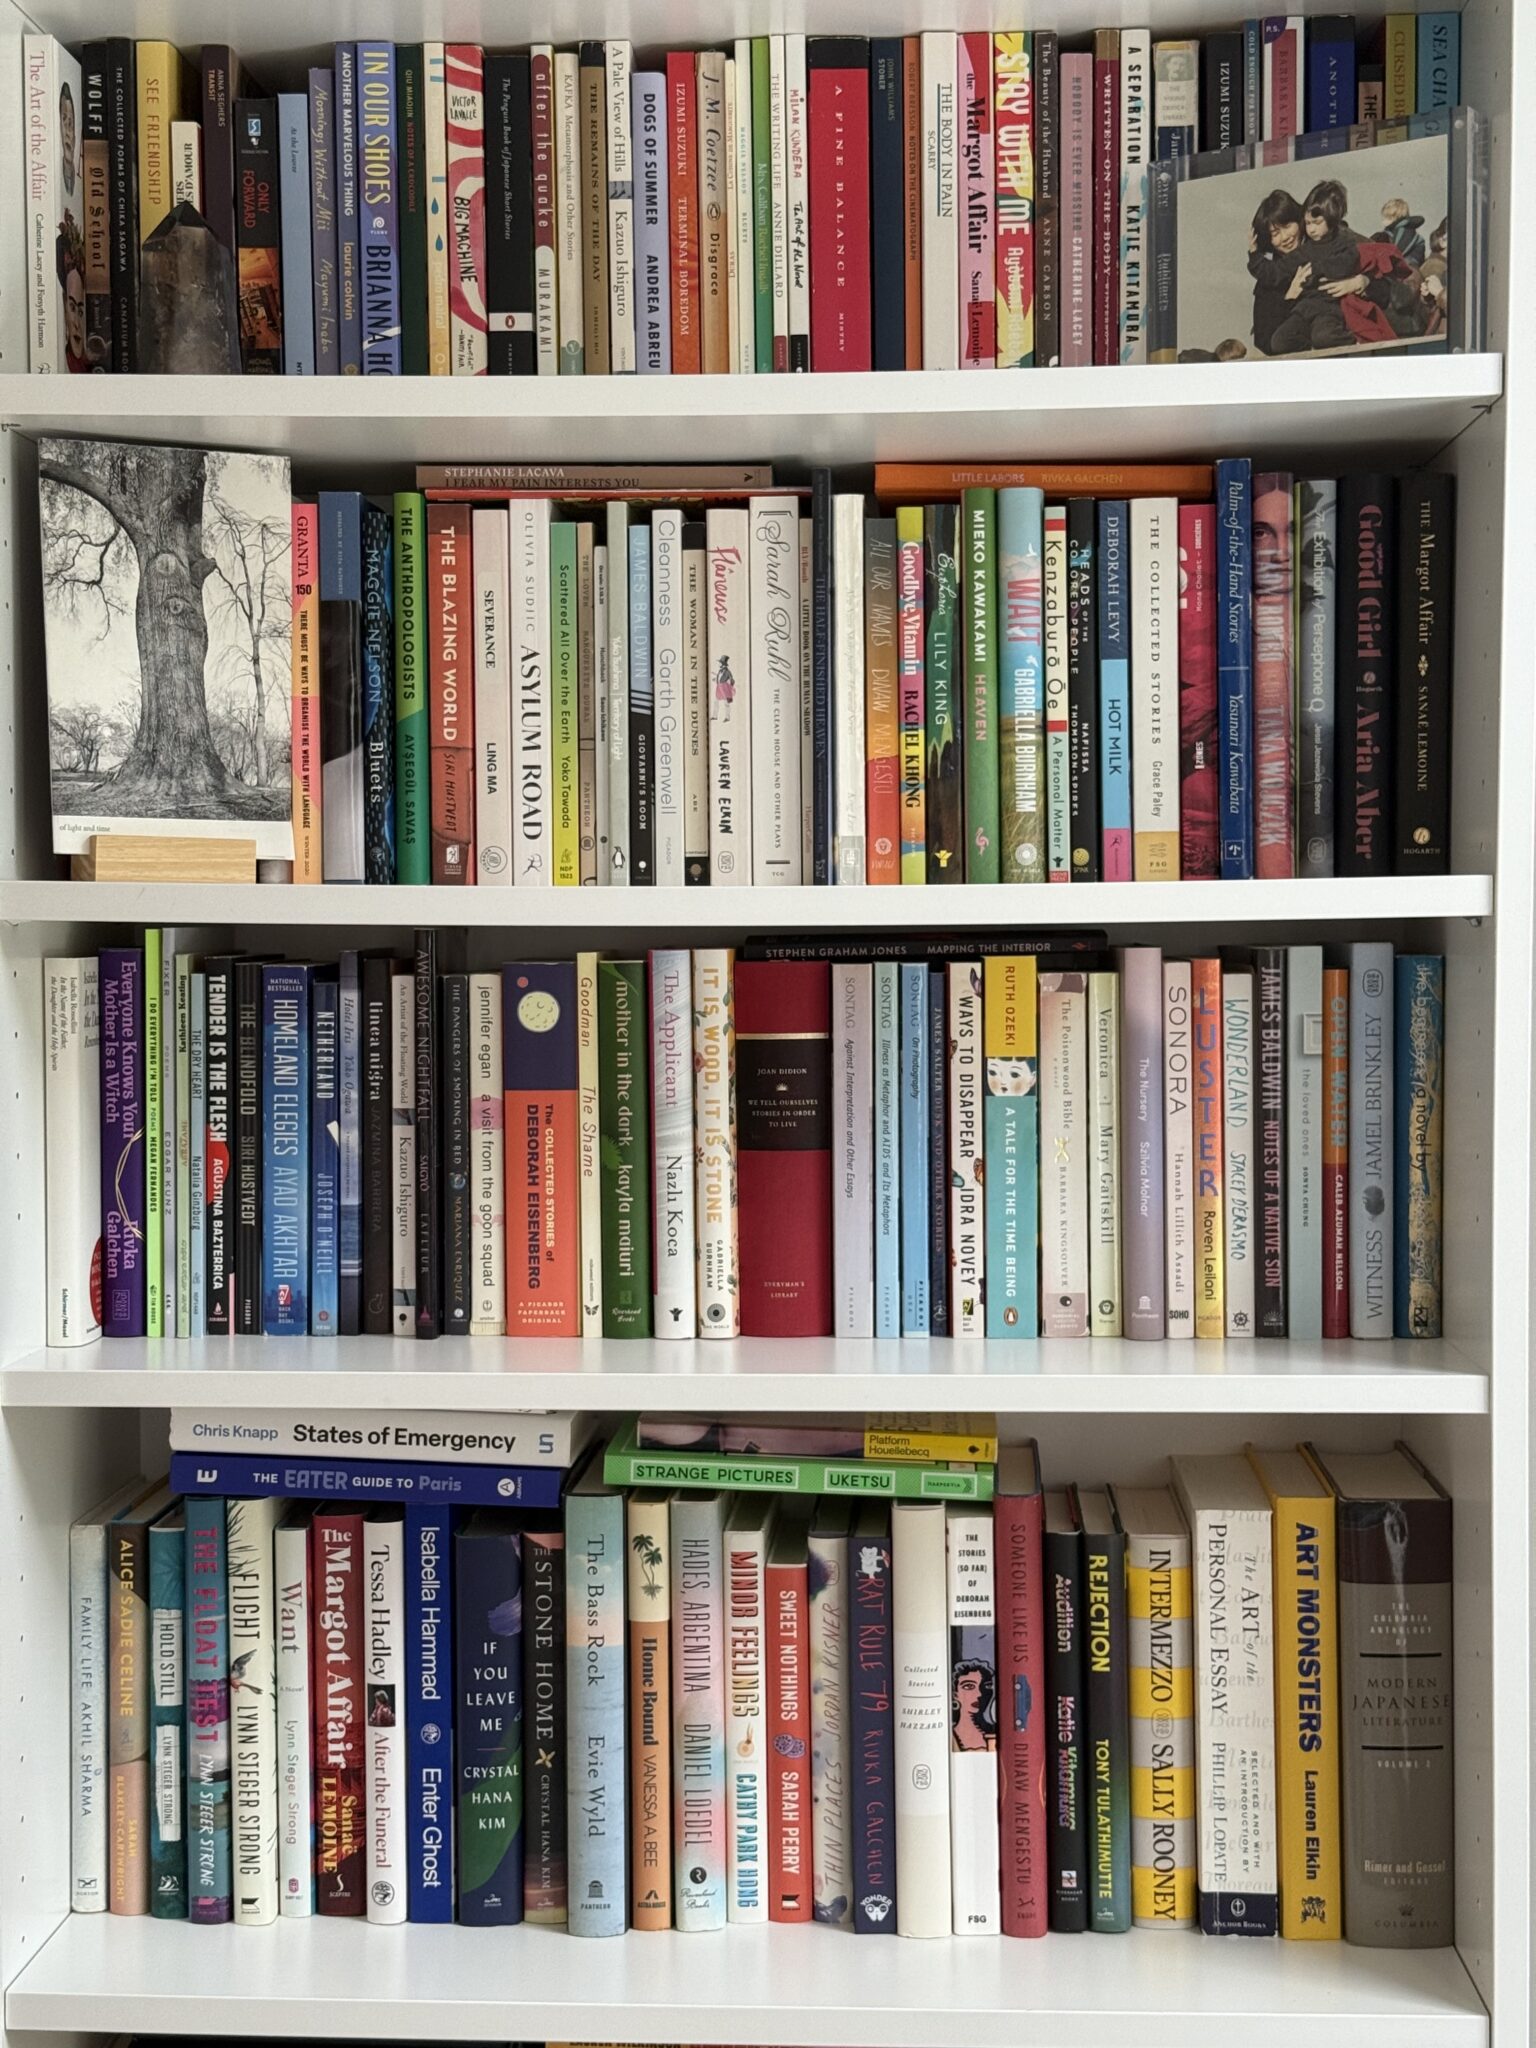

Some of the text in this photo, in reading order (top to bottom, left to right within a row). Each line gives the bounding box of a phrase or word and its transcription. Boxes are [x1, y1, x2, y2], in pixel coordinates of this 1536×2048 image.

[30, 51, 46, 201] The Art of the Affair
[88, 74, 102, 134] WOLFF
[147, 78, 161, 205] SEE FRIENDSHIP
[342, 52, 354, 216] ANOTHER MARVELOUS THING
[364, 52, 391, 204] IN OUR SHOES
[536, 74, 551, 227] after the quake
[644, 94, 657, 225] DOGS OF SUMMER
[1127, 64, 1142, 165] SEPARATION
[118, 181, 125, 193] OF
[118, 197, 126, 226] CHIKA
[835, 85, 845, 287] A FINE BALANCE
[34, 213, 45, 348] Catherine Lacey and Forsyth Harmon
[119, 231, 127, 272] SAGAWA
[538, 269, 552, 354] MURAKAMI
[646, 255, 660, 369] ANDREA ABREU
[1126, 205, 1140, 343] KATIE KITAMURA
[295, 585, 312, 595] 150
[296, 516, 308, 577] GRANTA
[401, 508, 416, 700] THE ANTHROPOLOGISTS
[1106, 516, 1121, 643] DEBORAH LEVY
[1225, 481, 1244, 644] Palm-of-the-Hand Stories
[1416, 500, 1435, 644] THE Margot Affair
[440, 526, 457, 741] THE BLAZING WORLD
[560, 565, 571, 743] Scattered All Over the Earth
[300, 610, 311, 829] THERE MUST BE WAYS TO ORGANISE THE WORLD WITH LANGUAGE
[1228, 694, 1244, 814] Yasunari Kawabata
[209, 975, 227, 1142] TENDER IS THE FLESH
[478, 986, 493, 1079] jennifer egan
[1005, 966, 1016, 1047] RUTH OZEKI
[958, 995, 975, 1159] WAYS TO DISAPPEAR
[479, 1094, 494, 1287] a visit from the goon squad
[526, 1104, 541, 1289] DEBORAH EISENBERG
[544, 1104, 555, 1261] The COLLECTED STORIES of
[1005, 1107, 1016, 1297] A TALE FOR THE TIME BEING
[1203, 1210, 1216, 1300] Raven Leilani
[193, 1424, 279, 1441] Chris Knapp
[253, 1470, 462, 1492] THE EATER GUIDE TO Paris
[293, 1424, 516, 1453] States of Emergency
[636, 1465, 793, 1484] STRANGE PICTURES
[829, 1473, 890, 1488] UKETSU
[80, 1597, 93, 1688] FAMILY LIFE
[159, 1623, 176, 1699] HOLD STILL
[369, 1545, 391, 1679] Tessa Hadley
[421, 1526, 441, 1699] Isabella Hammad
[587, 1534, 604, 1687] The Bass Rock
[779, 1590, 797, 1721] SWEET NOTHINGS
[1089, 1555, 1110, 1672] REJECTION
[1149, 1549, 1173, 1703] INTERMEZZO
[1295, 1522, 1322, 1752] ART MONSTERS
[81, 1702, 93, 1817] AKHIL SHARMA
[163, 1736, 174, 1825] LYNN STEGER STRONG
[583, 1735, 605, 1838] Evie Wyld
[781, 1771, 799, 1874] SARAH PERRY
[1096, 1740, 1112, 1899] TONY TULATHIMUTTE
[422, 1768, 442, 1887] Enter Ghost
[1151, 1744, 1176, 1921] SALLY ROONEY
[1304, 1770, 1320, 1880] Lauren Elkin
